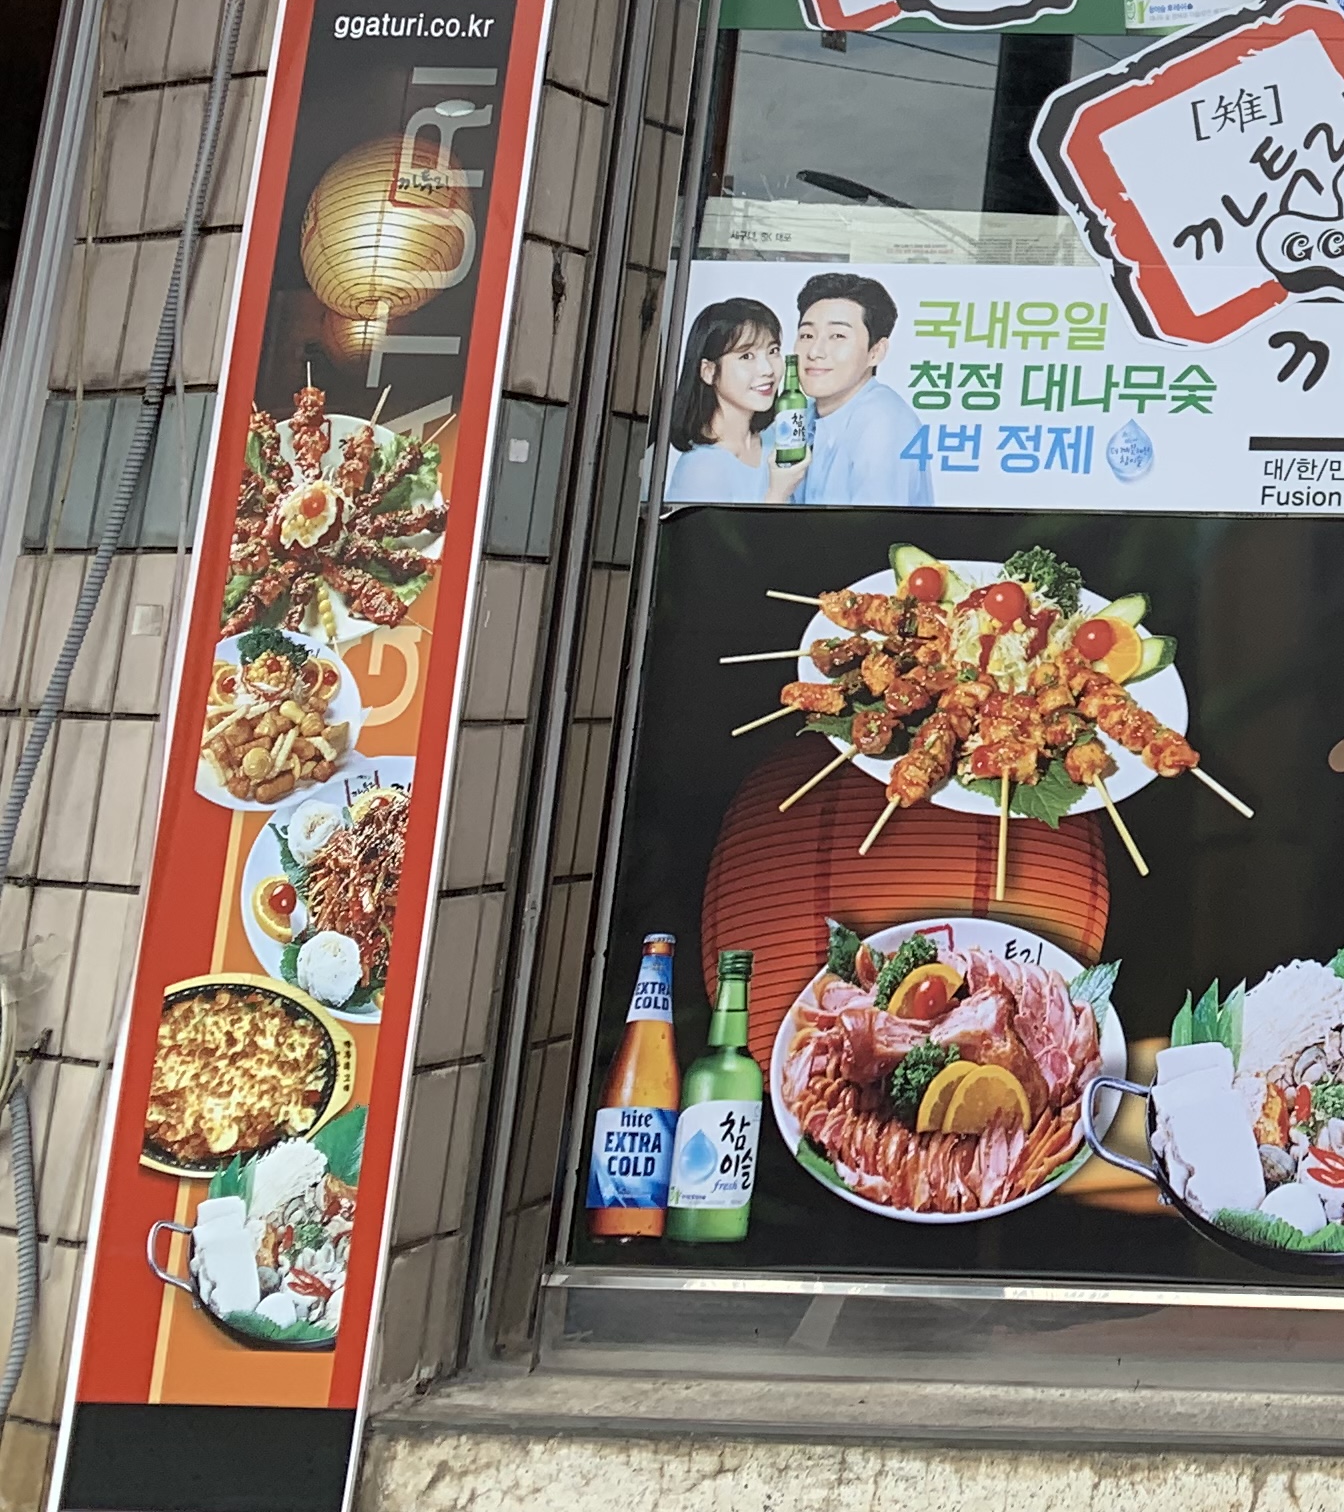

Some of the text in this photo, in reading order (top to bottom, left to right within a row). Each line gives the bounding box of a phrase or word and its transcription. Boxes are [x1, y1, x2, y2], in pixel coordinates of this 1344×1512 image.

[334, 13, 495, 39] ggaturi.co.kr
[913, 300, 1110, 352] 국내유일
[908, 361, 1003, 413] 청정
[899, 423, 1096, 476] 4번 정제
[1261, 486, 1344, 506] Fusion
[635, 981, 671, 996] EXTRA
[634, 996, 670, 1011] COLD
[620, 1109, 653, 1128] hite
[604, 1131, 662, 1153] EXTRA
[607, 1155, 656, 1178] COLD
[711, 1179, 738, 1193] fresh
